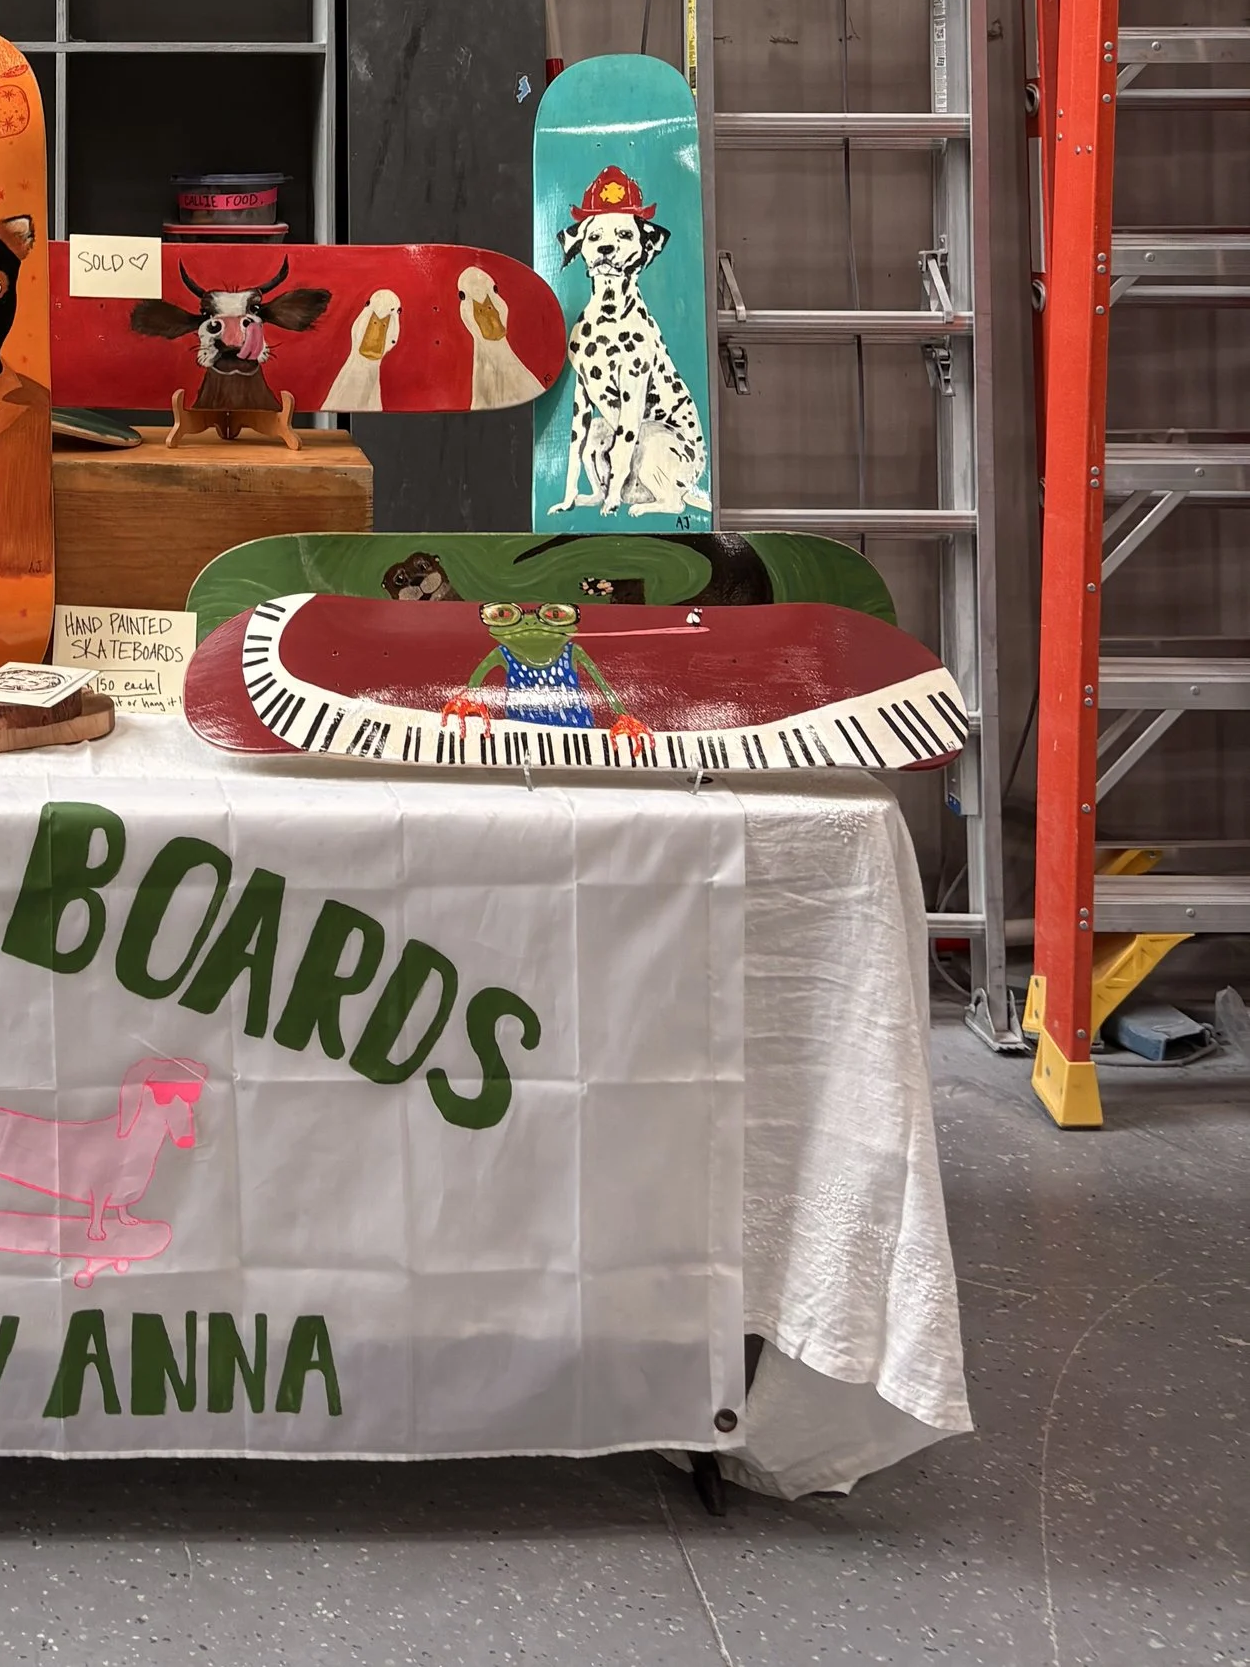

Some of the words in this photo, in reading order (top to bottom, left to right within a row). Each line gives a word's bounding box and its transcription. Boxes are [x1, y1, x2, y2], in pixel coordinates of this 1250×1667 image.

[77, 251, 124, 273] SOLD
[64, 611, 103, 637] HAND
[109, 612, 173, 635] PAINTED
[71, 637, 184, 663] SKATEBOARDS
[124, 678, 156, 691] each
[127, 699, 137, 707] or
[141, 697, 166, 712] hang
[1, 801, 540, 1130] BOARDS
[43, 1309, 343, 1418] ANNA
